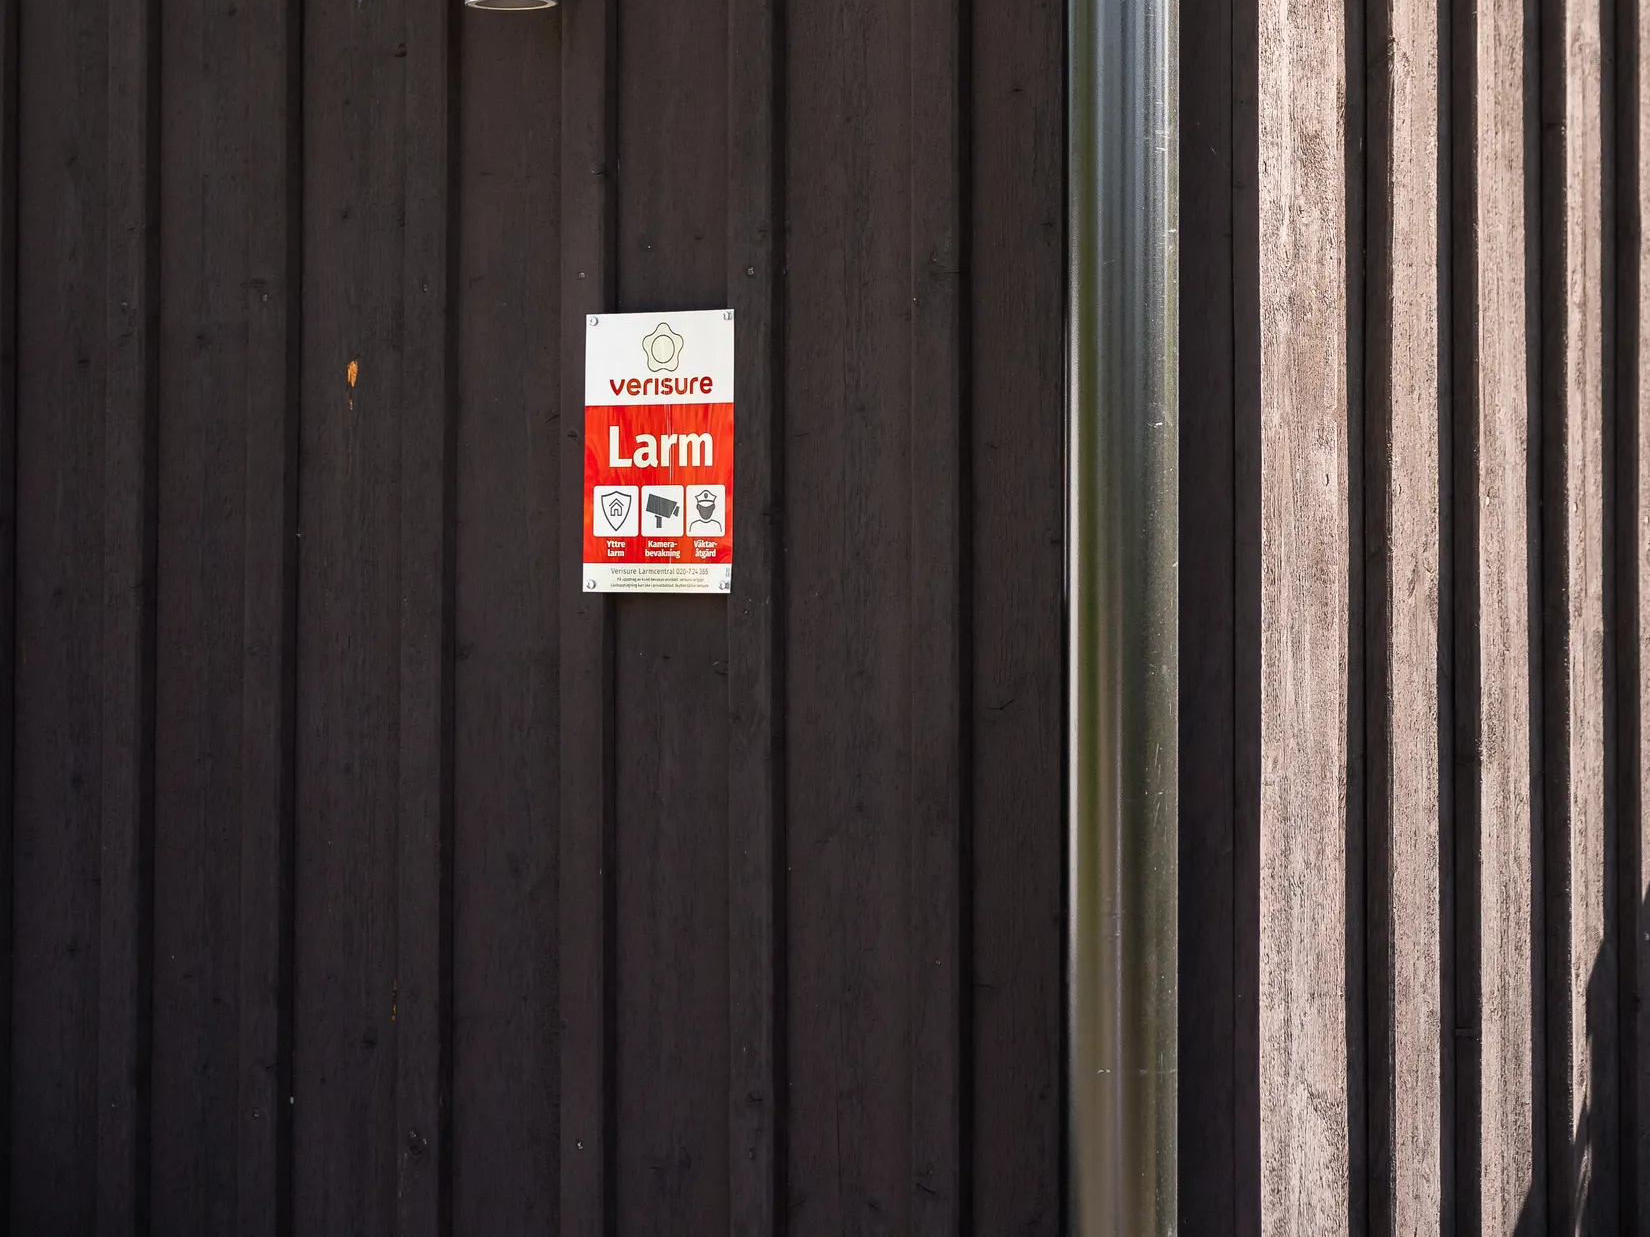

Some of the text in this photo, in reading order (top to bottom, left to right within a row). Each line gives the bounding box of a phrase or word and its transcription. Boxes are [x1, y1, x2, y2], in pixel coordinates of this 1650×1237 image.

[609, 376, 713, 396] verisure
[609, 425, 713, 468] Larm
[606, 540, 626, 548] Yttre
[647, 540, 678, 548] Kamera-
[693, 539, 718, 548] Väktar-
[607, 549, 625, 557] larm
[645, 549, 681, 559] bevakning
[695, 548, 716, 559] åtgärd
[610, 567, 637, 575] Verisure
[638, 567, 675, 575] Larmcentral
